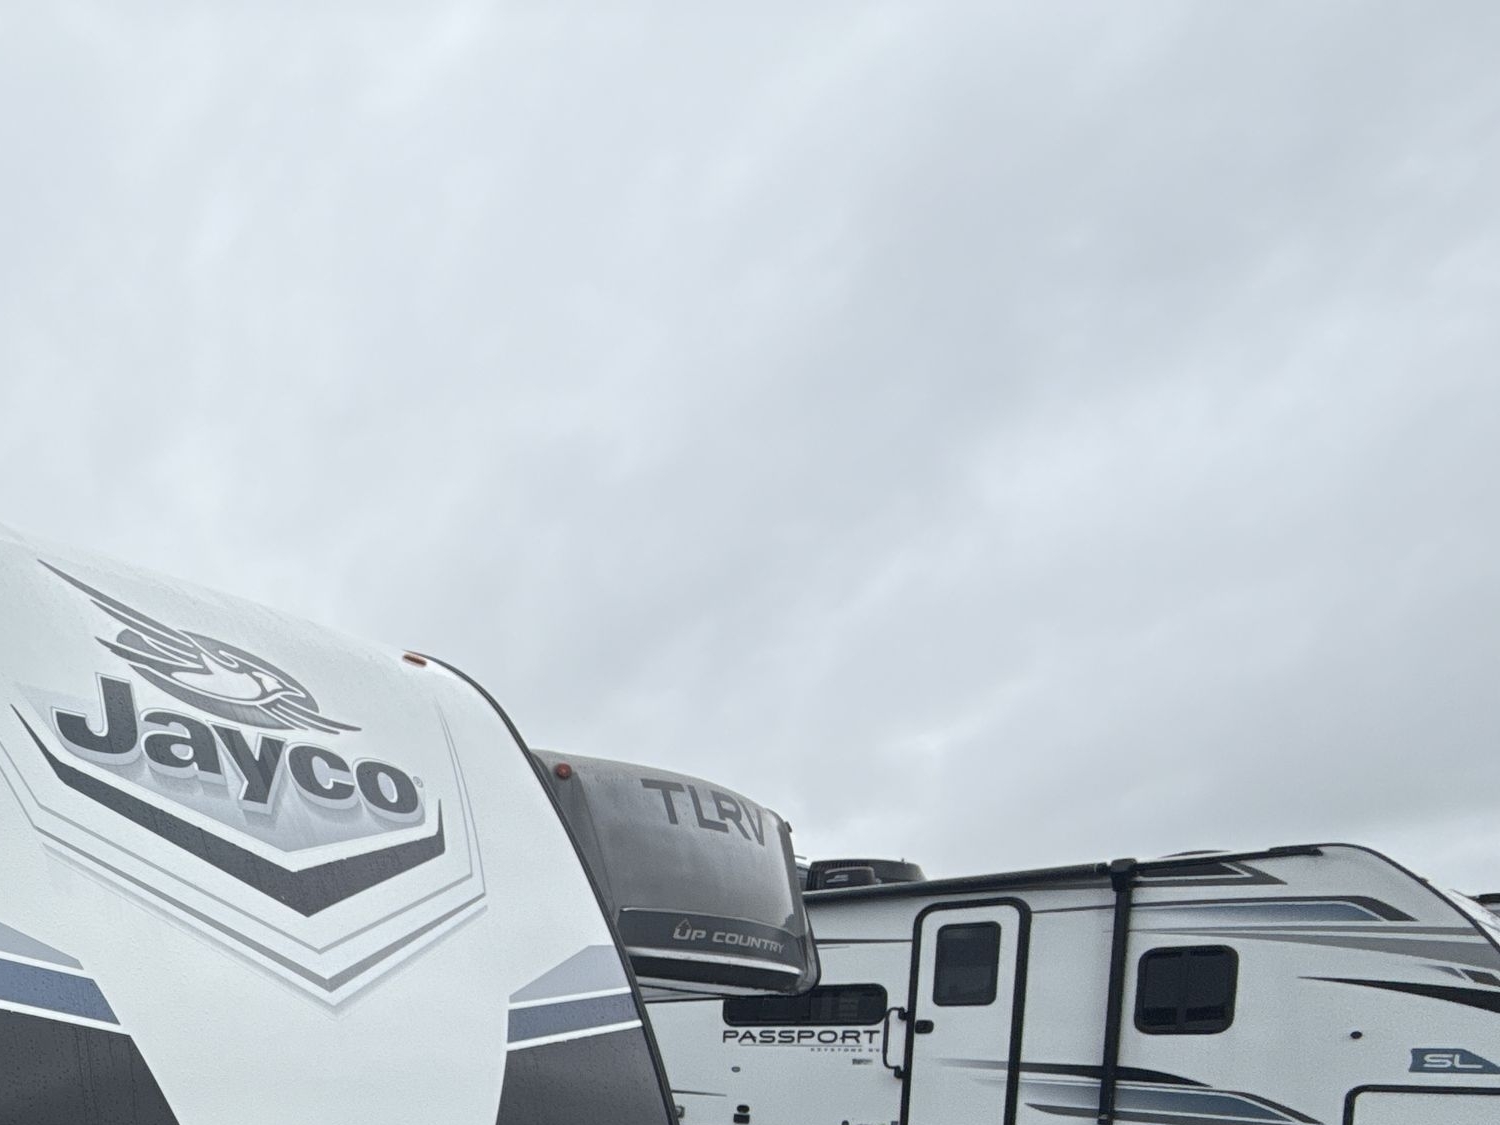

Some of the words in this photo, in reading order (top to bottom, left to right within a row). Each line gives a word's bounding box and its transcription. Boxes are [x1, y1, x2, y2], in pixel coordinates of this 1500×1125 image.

[52, 673, 422, 815] Jayco
[640, 778, 765, 847] TLRV
[673, 923, 707, 941] UP
[712, 931, 785, 953] COUNTRY
[722, 1029, 880, 1044] PASSPORT
[1423, 1053, 1483, 1069] SL
